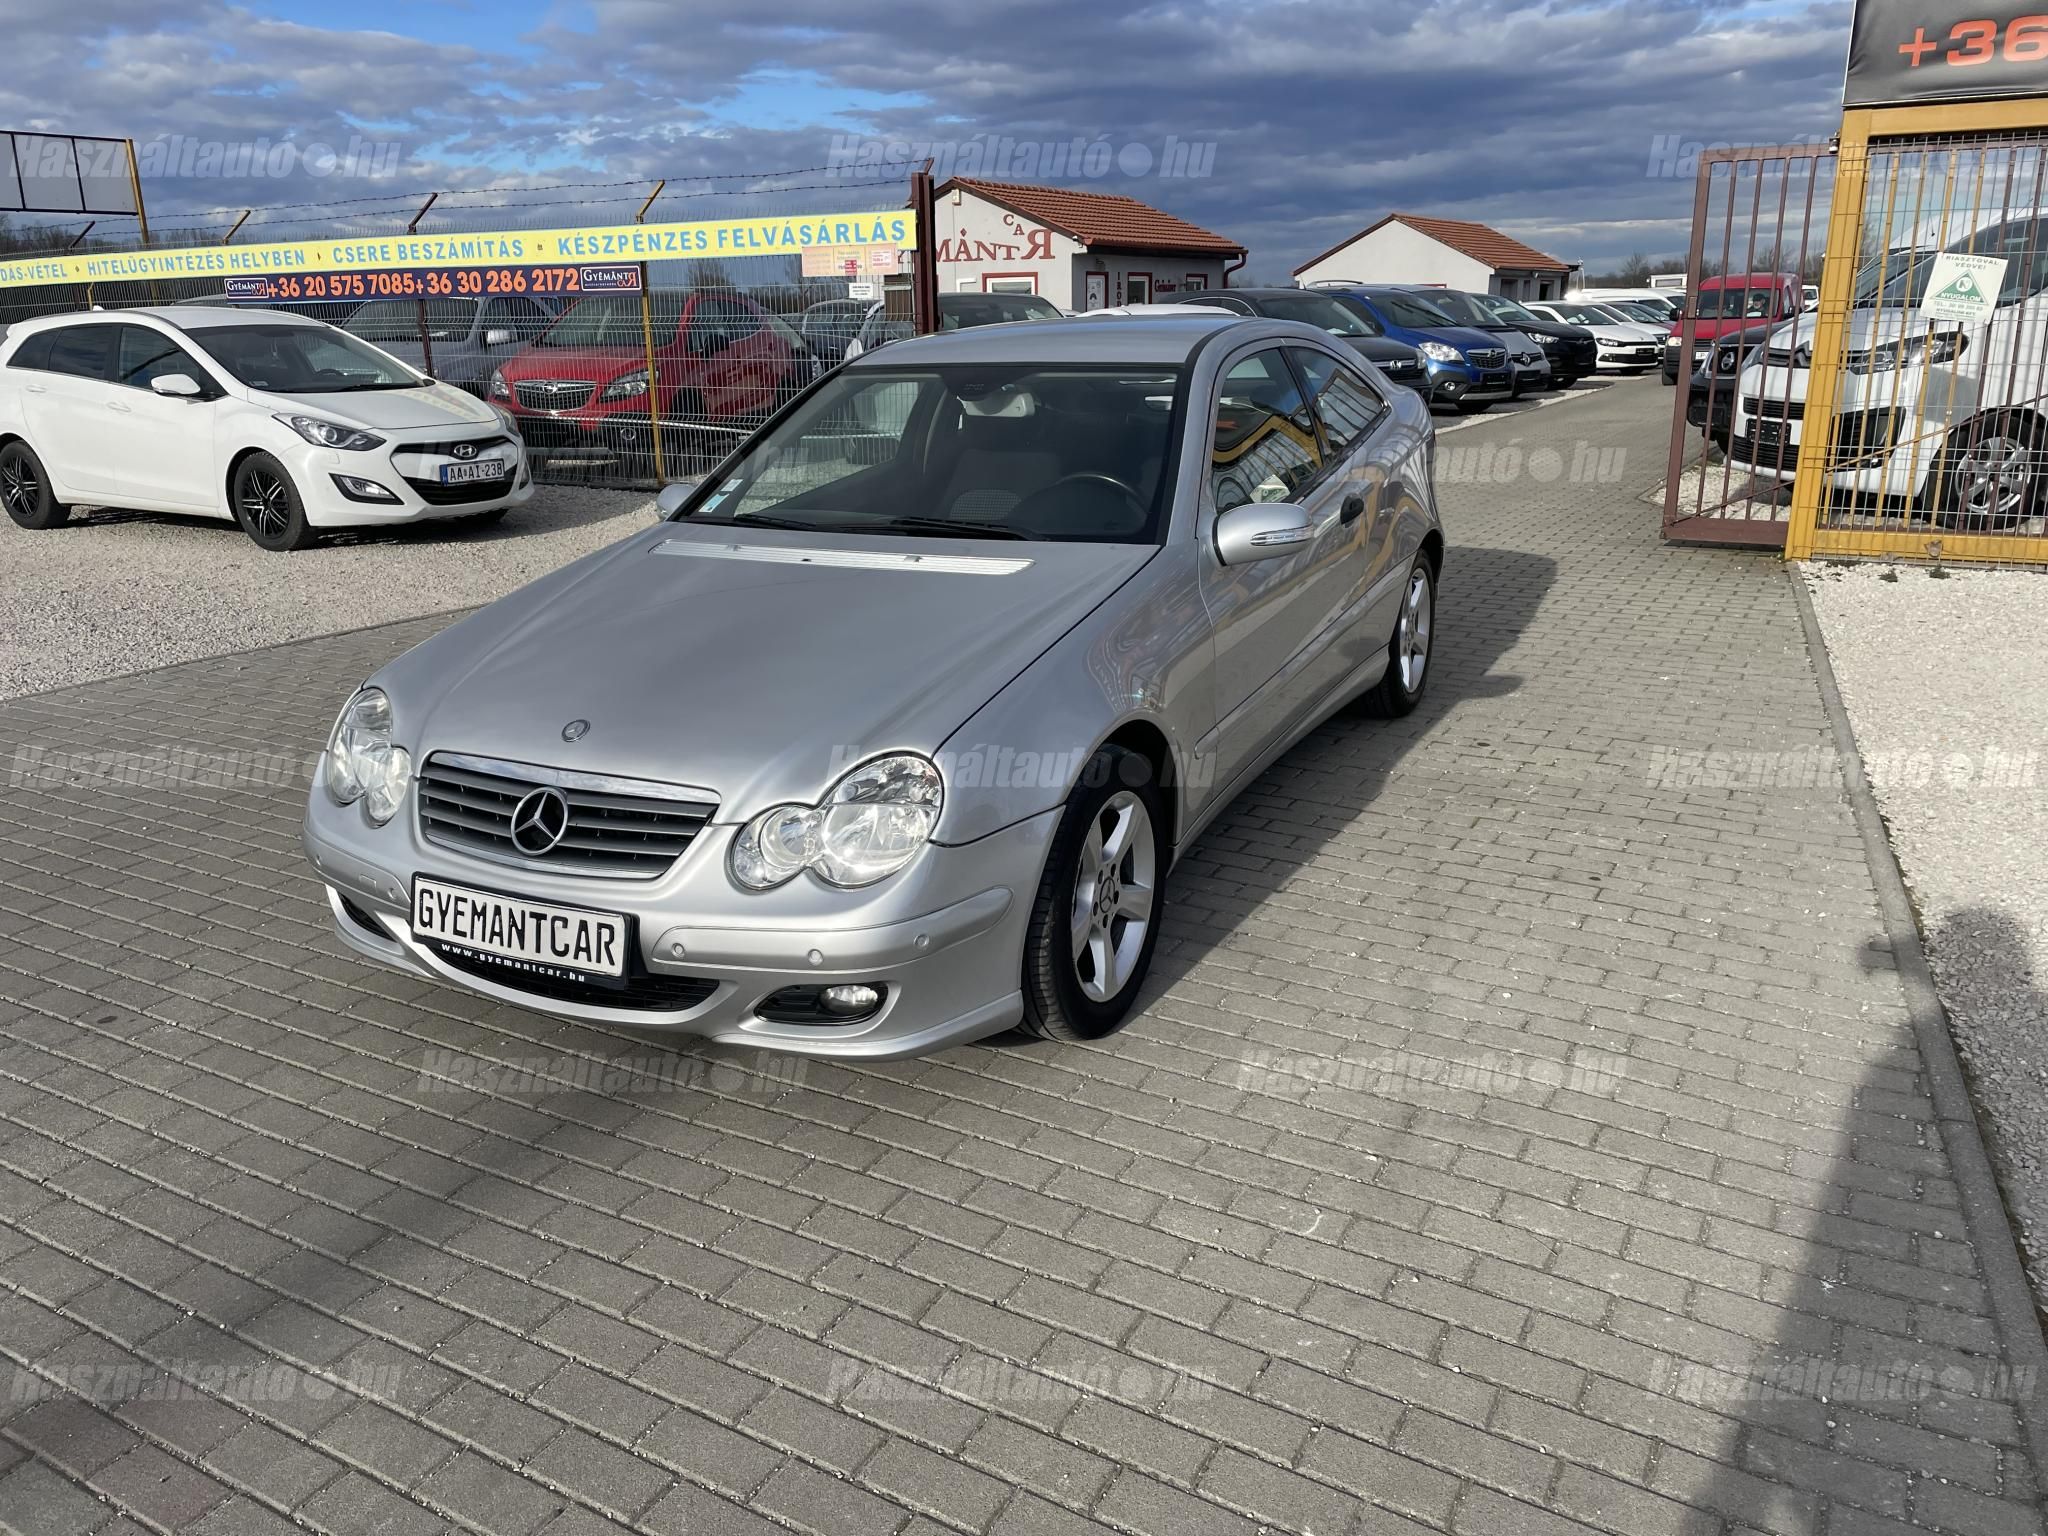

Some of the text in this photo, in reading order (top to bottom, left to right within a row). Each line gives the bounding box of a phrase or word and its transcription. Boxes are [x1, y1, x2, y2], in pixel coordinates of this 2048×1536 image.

[1898, 14, 2048, 67] +36
[87, 250, 225, 276] HITELÜGYINTÉZÉS
[230, 249, 305, 269] HELYBEN
[333, 243, 391, 263] CSERE
[397, 235, 524, 261] BESZÁMÍTÁS
[558, 229, 708, 256] KÉSZPÉNZES
[718, 216, 906, 249] FELVÁSÁRLÁS
[268, 276, 301, 298] +36
[303, 275, 326, 297] 20
[330, 274, 365, 296] 575
[457, 271, 482, 293] 30
[486, 270, 527, 292] 286
[531, 268, 580, 292] 2172
[418, 887, 617, 967] GYEMANTCAR
[441, 943, 586, 982] www.gyemantcar.hu
